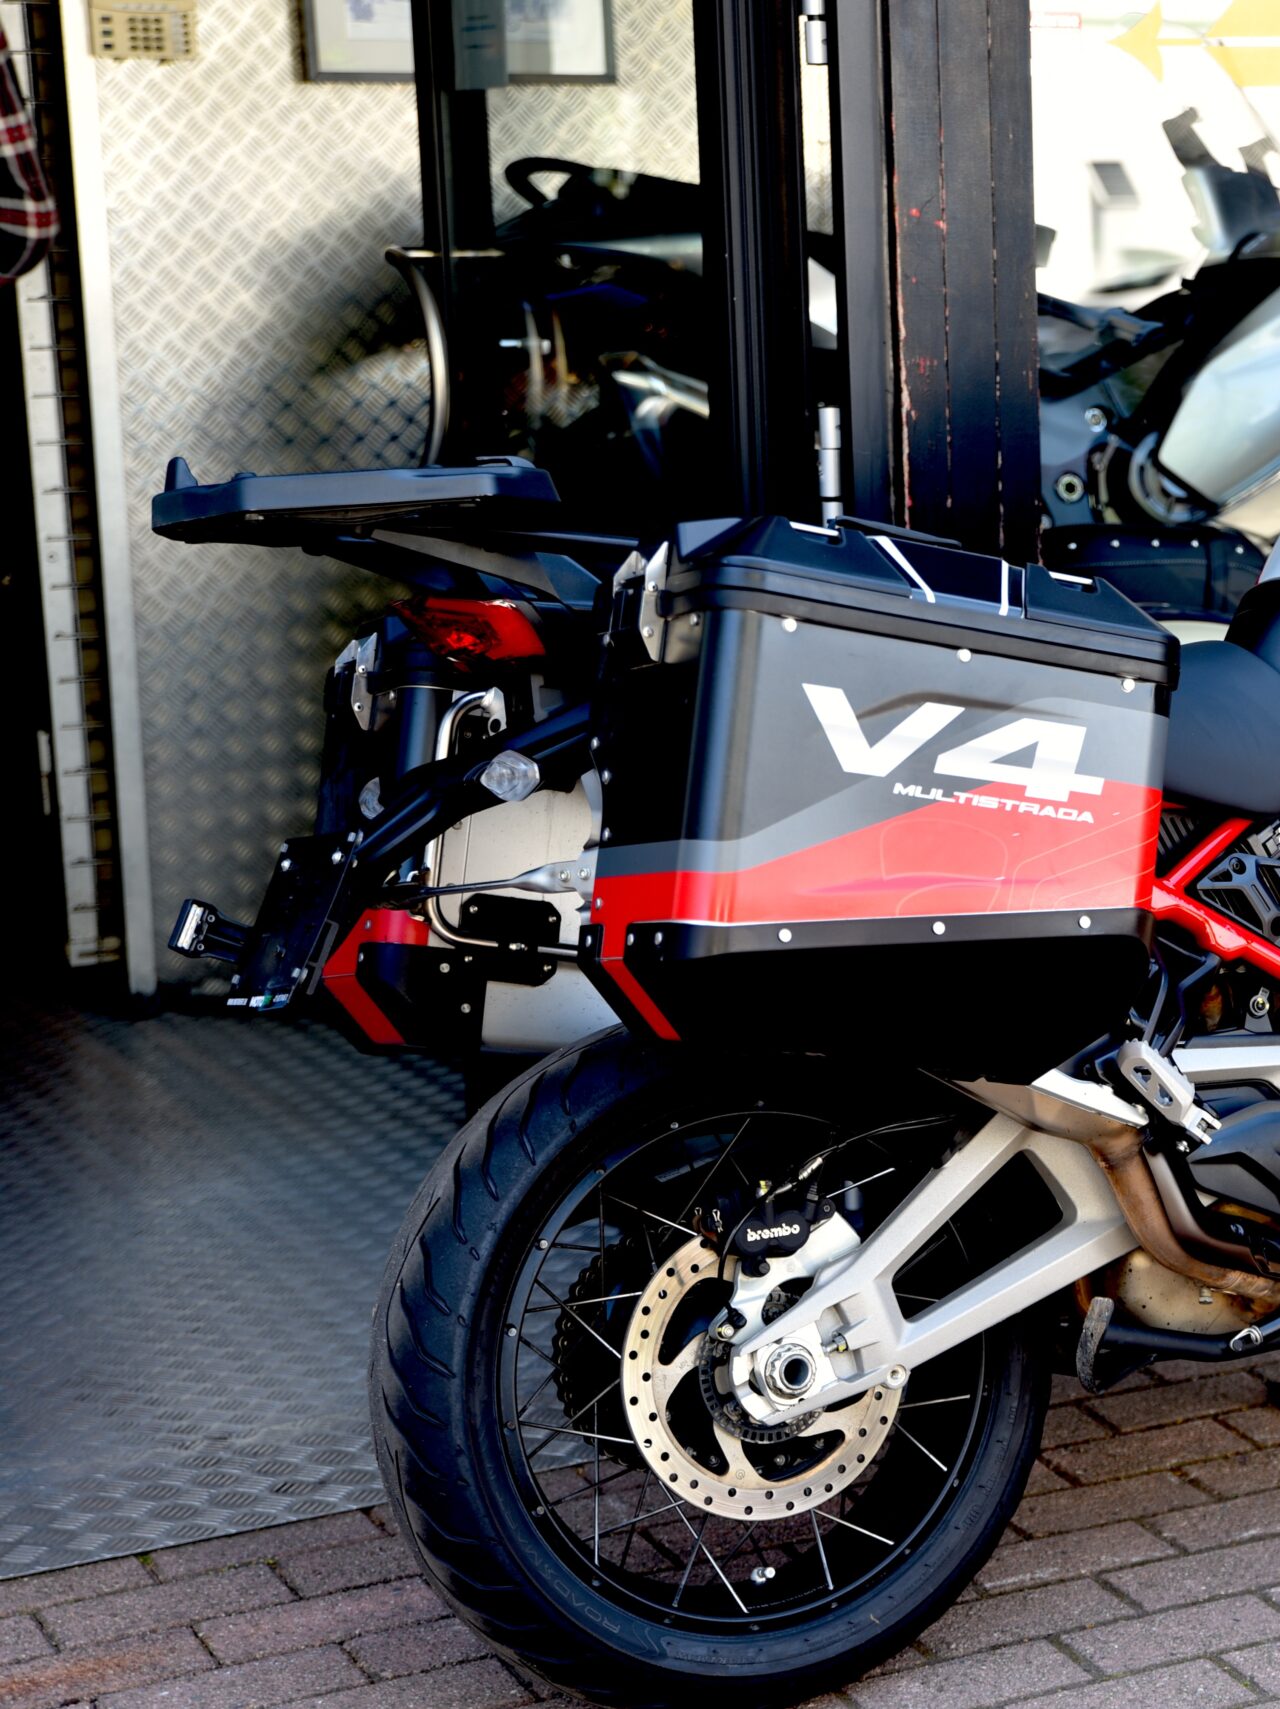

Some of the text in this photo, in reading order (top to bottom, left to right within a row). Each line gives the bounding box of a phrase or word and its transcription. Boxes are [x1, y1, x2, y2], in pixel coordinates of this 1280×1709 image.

[802, 683, 1104, 802] V4
[893, 783, 1094, 824] MULTISTRADA
[746, 1222, 801, 1242] brembo
